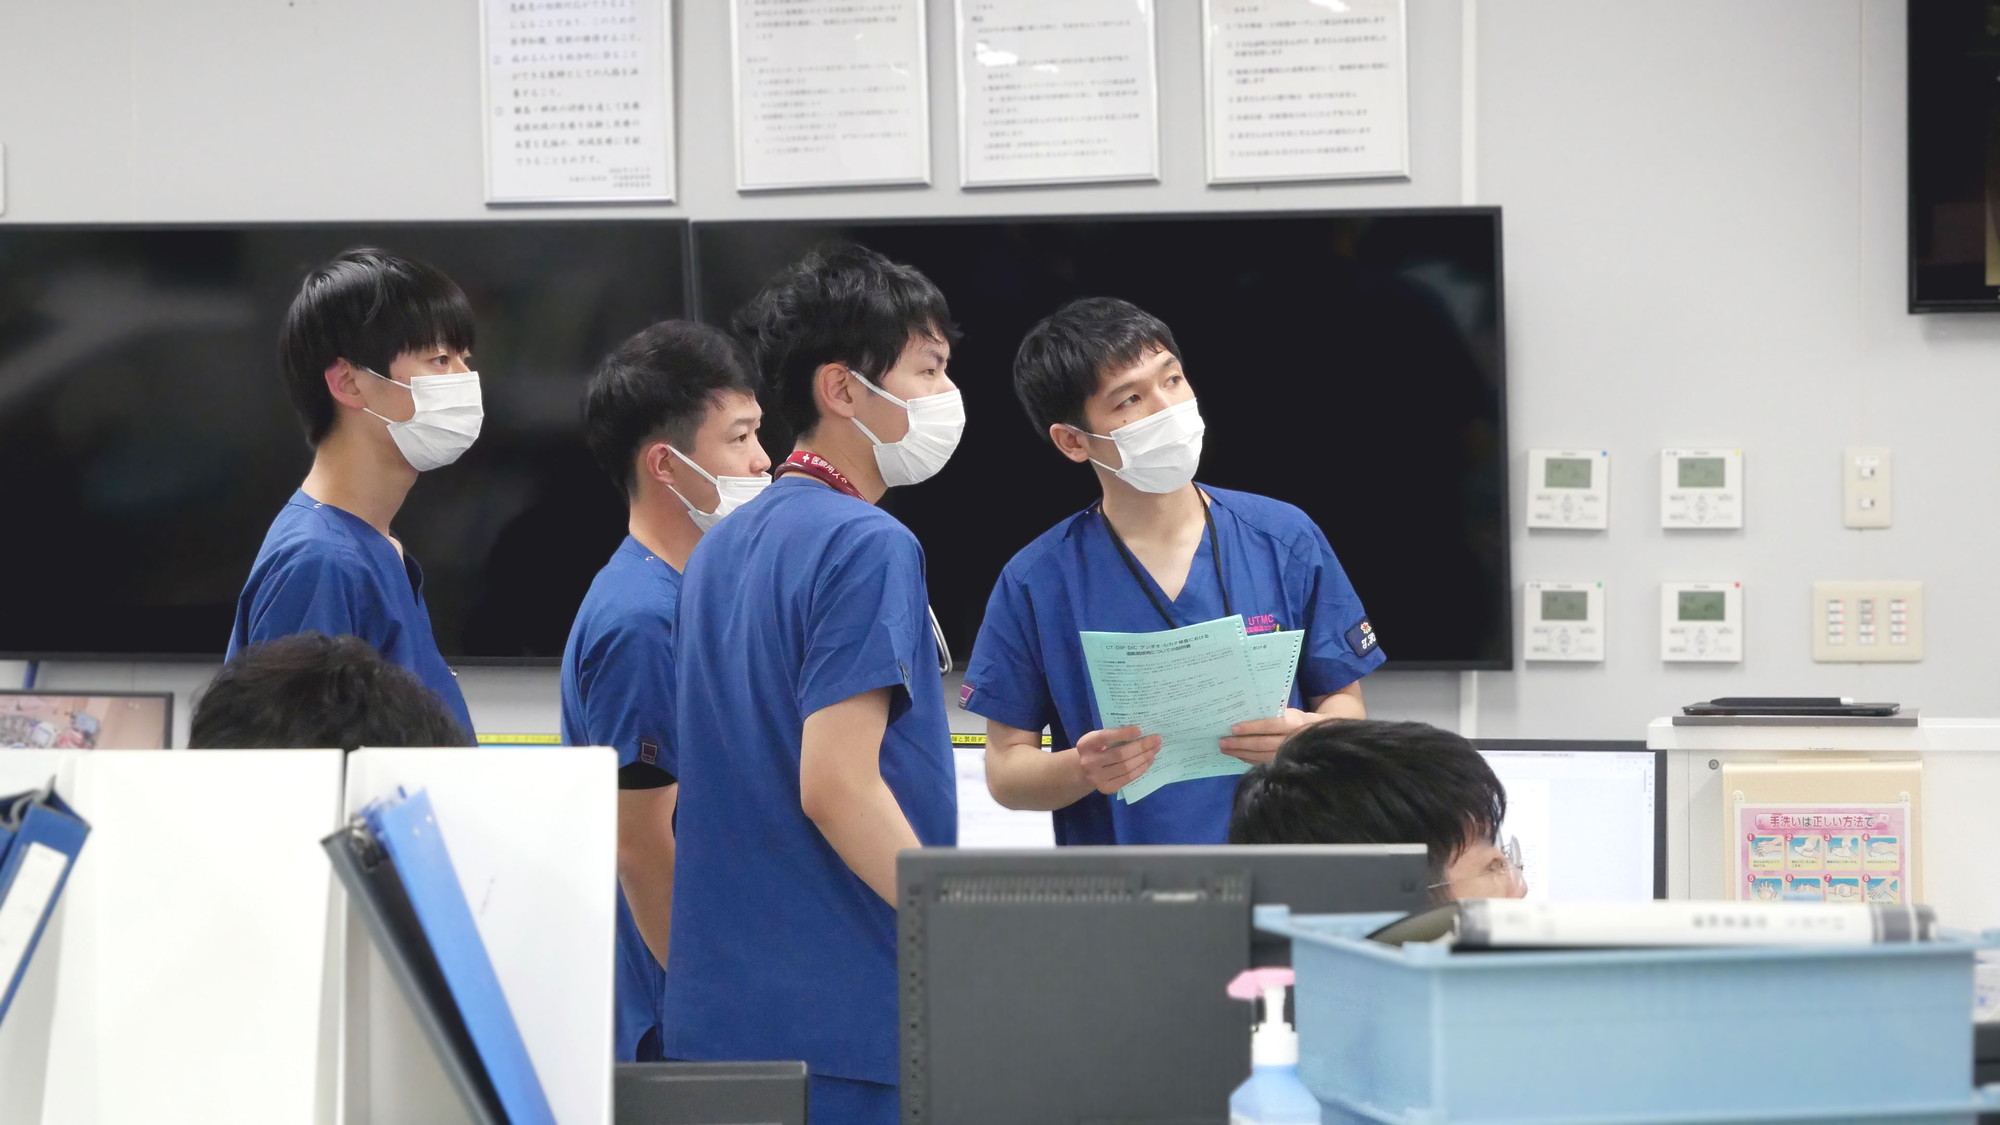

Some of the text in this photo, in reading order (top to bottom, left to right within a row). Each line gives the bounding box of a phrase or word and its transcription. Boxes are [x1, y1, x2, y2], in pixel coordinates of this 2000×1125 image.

[1247, 614, 1274, 625] UTMC
[1770, 816, 1874, 828] 手洗いは正しい方法で
